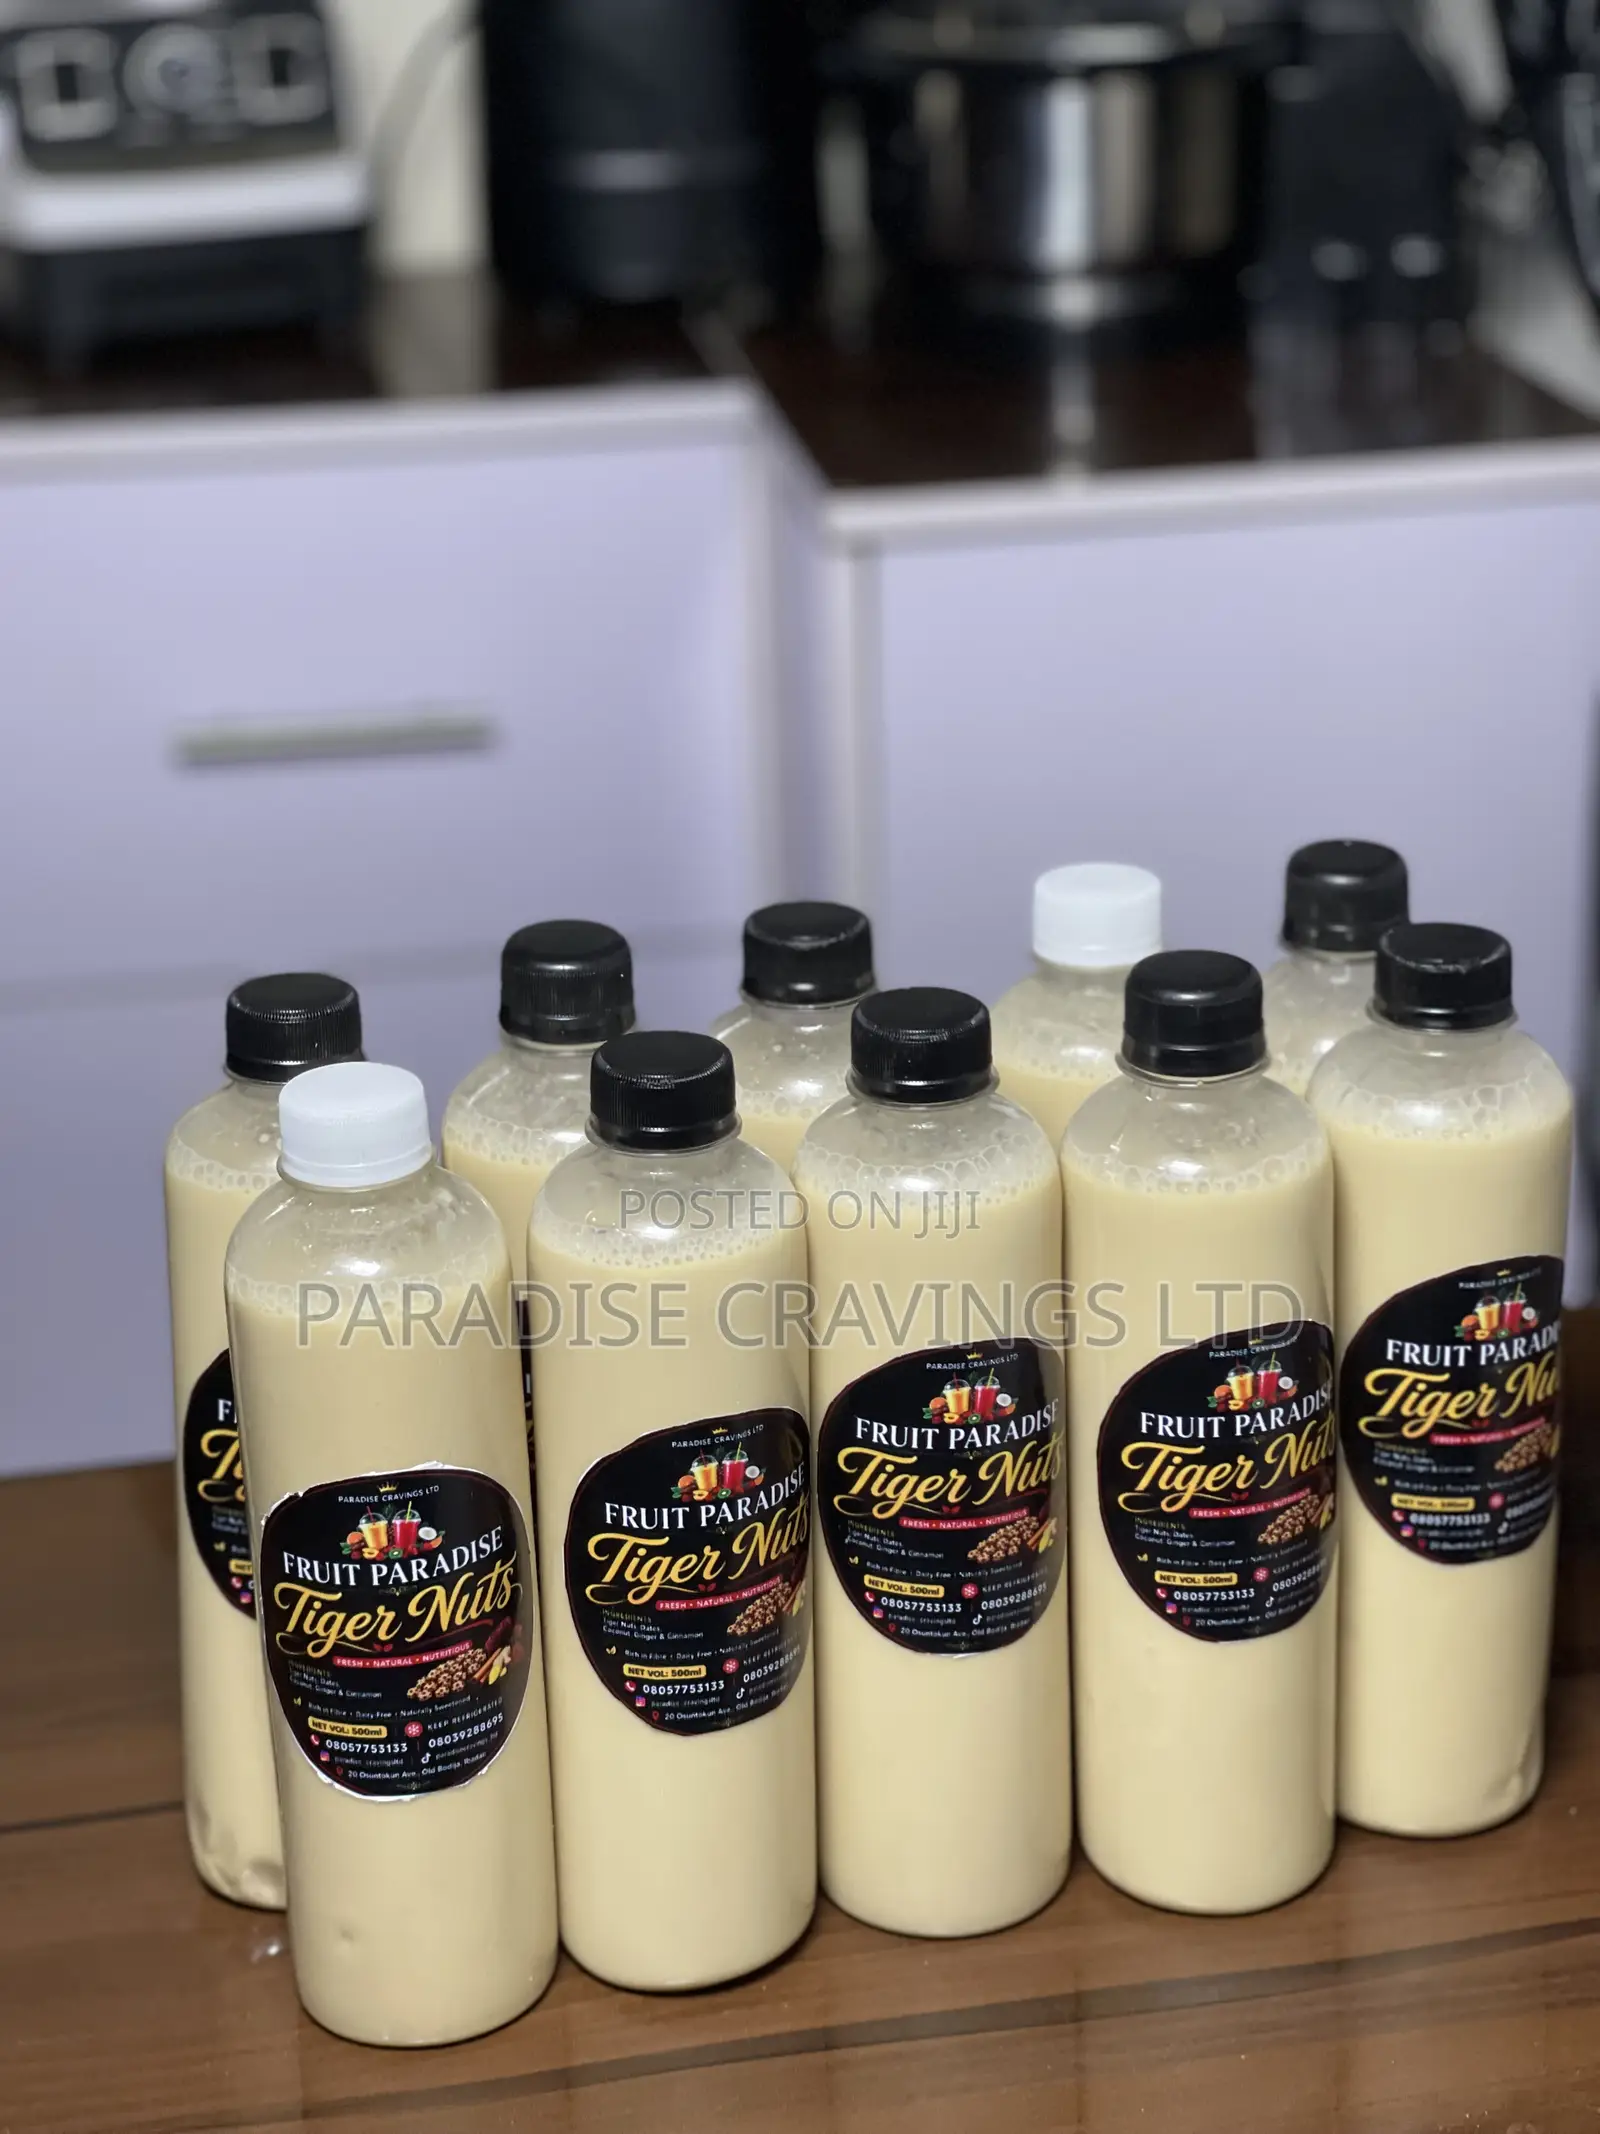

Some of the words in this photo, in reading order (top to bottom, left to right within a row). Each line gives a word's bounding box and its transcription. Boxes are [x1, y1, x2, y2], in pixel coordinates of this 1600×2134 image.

[1386, 1338, 1472, 1367] FRUIT
[926, 1362, 966, 1370] PARADISE
[968, 1356, 1005, 1369] CRAVINGS
[1358, 1367, 1498, 1439] Tiger
[1499, 1351, 1558, 1417] Nu
[1140, 1411, 1225, 1438] FRUIT
[1235, 1382, 1331, 1436] PARADIS
[855, 1417, 940, 1449] FRUIT
[949, 1398, 1059, 1450] PARADISE
[671, 1438, 711, 1448] PARADISE
[714, 1429, 751, 1444] CRAVINGS
[833, 1446, 972, 1519] Tiger
[973, 1431, 1063, 1507] Nuts
[1118, 1441, 1259, 1513] Tiger
[338, 1495, 379, 1503] PARADISE
[382, 1489, 423, 1502] CRAVINGS
[425, 1485, 440, 1495] LTD
[604, 1501, 690, 1529] FRUIT
[700, 1462, 805, 1527] PARADISE
[903, 1520, 930, 1528] FRESH
[940, 1520, 977, 1529] NATURAL
[283, 1551, 360, 1586] FRUIT
[371, 1525, 503, 1586] PARADISE
[586, 1532, 726, 1605] Tiger
[728, 1491, 809, 1579] Nuts
[868, 1578, 884, 1587] NET
[887, 1583, 908, 1592] VOL:
[910, 1586, 940, 1595] 500ml
[1160, 1574, 1177, 1582] NET
[660, 1600, 687, 1609] FRESH
[696, 1596, 733, 1608] NATURAL
[1173, 1588, 1255, 1601] 08057753133
[274, 1582, 401, 1658] Tiger
[405, 1551, 521, 1642] Nuts
[881, 1597, 962, 1613] 08057753133
[336, 1658, 363, 1667] FRESH
[373, 1658, 412, 1668] NATURAL
[422, 1643, 470, 1661] NUTRITIOUS
[628, 1667, 644, 1676] NET
[648, 1669, 668, 1678] VOL:
[671, 1667, 702, 1677] 500ml
[642, 1680, 725, 1695] 08057753133
[665, 1712, 675, 1720] 20
[312, 1720, 327, 1730] NET
[329, 1725, 349, 1734] VOL:
[352, 1727, 382, 1736] 500ml
[428, 1712, 504, 1748] 08039288695
[326, 1739, 408, 1753] 08057753133
[348, 1770, 357, 1778] 20
[421, 1768, 435, 1776] Old
